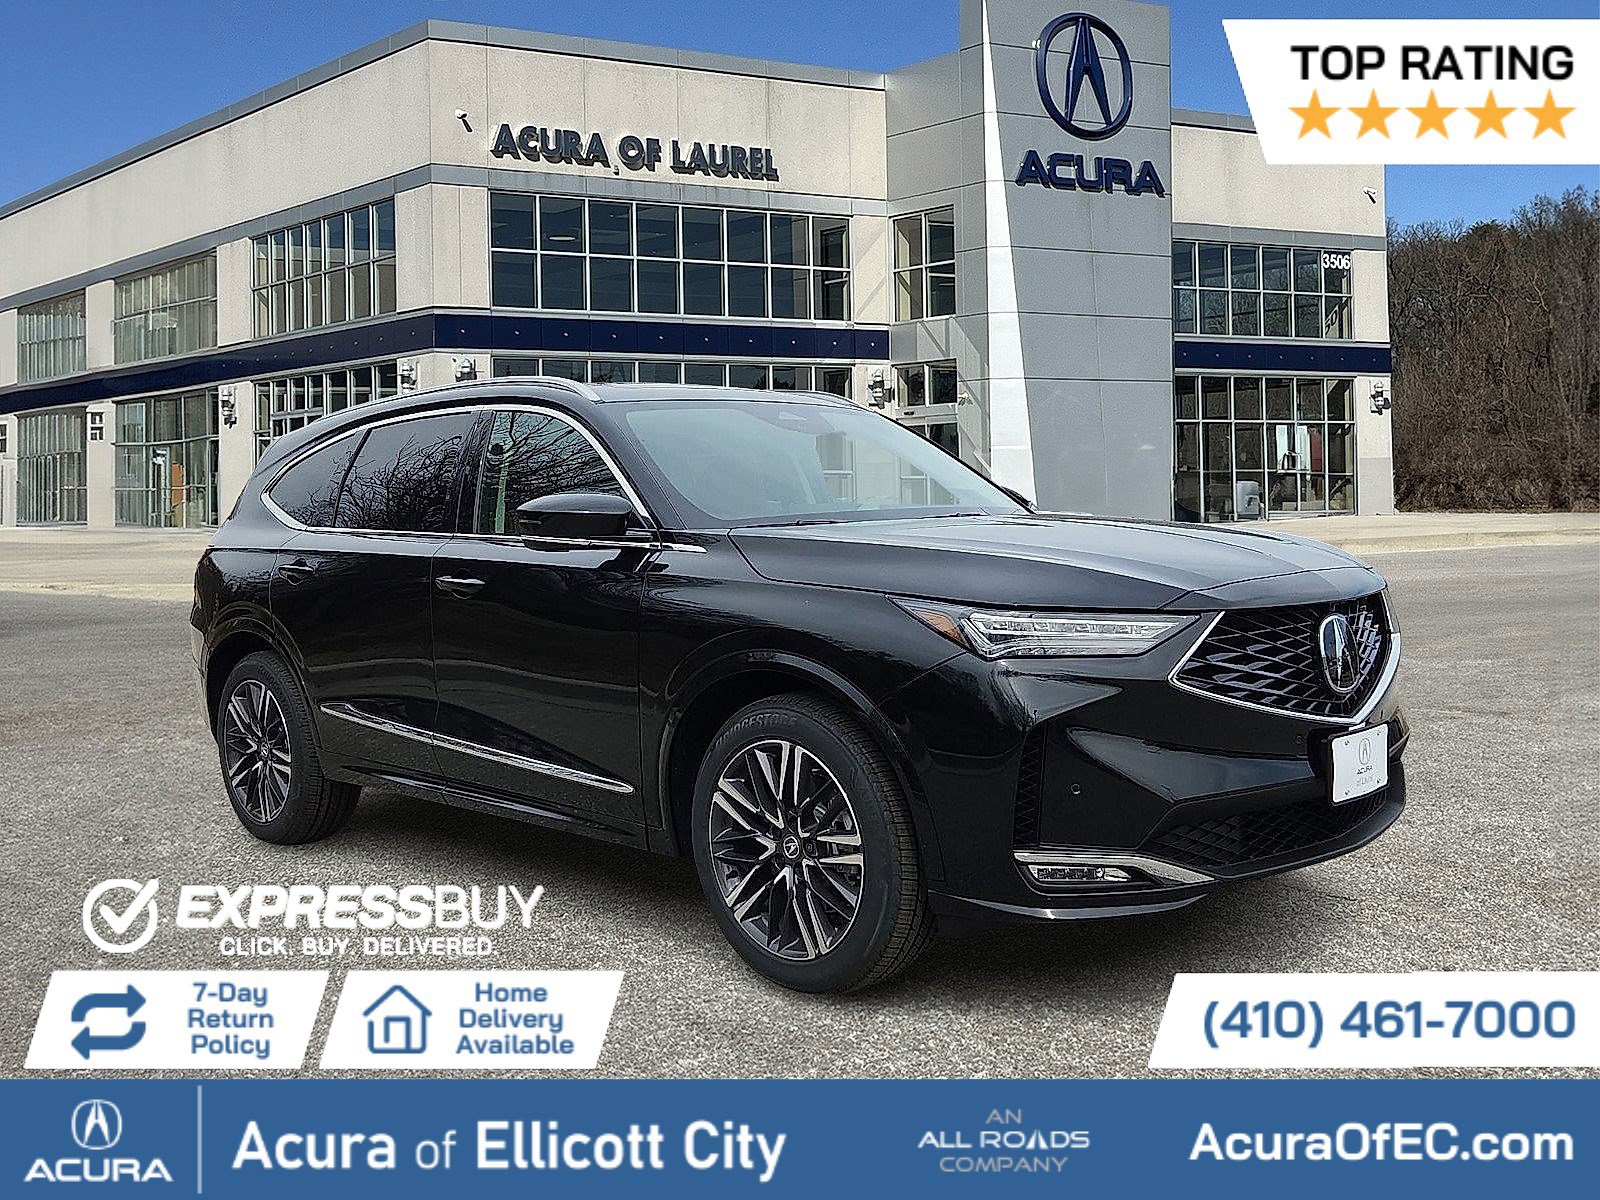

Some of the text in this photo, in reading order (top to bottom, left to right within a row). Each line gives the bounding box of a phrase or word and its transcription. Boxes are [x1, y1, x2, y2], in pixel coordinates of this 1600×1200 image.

[491, 124, 779, 181] ACURA OF LAUREL
[1015, 150, 1165, 198] ACURA
[1322, 254, 1351, 269] 3506
